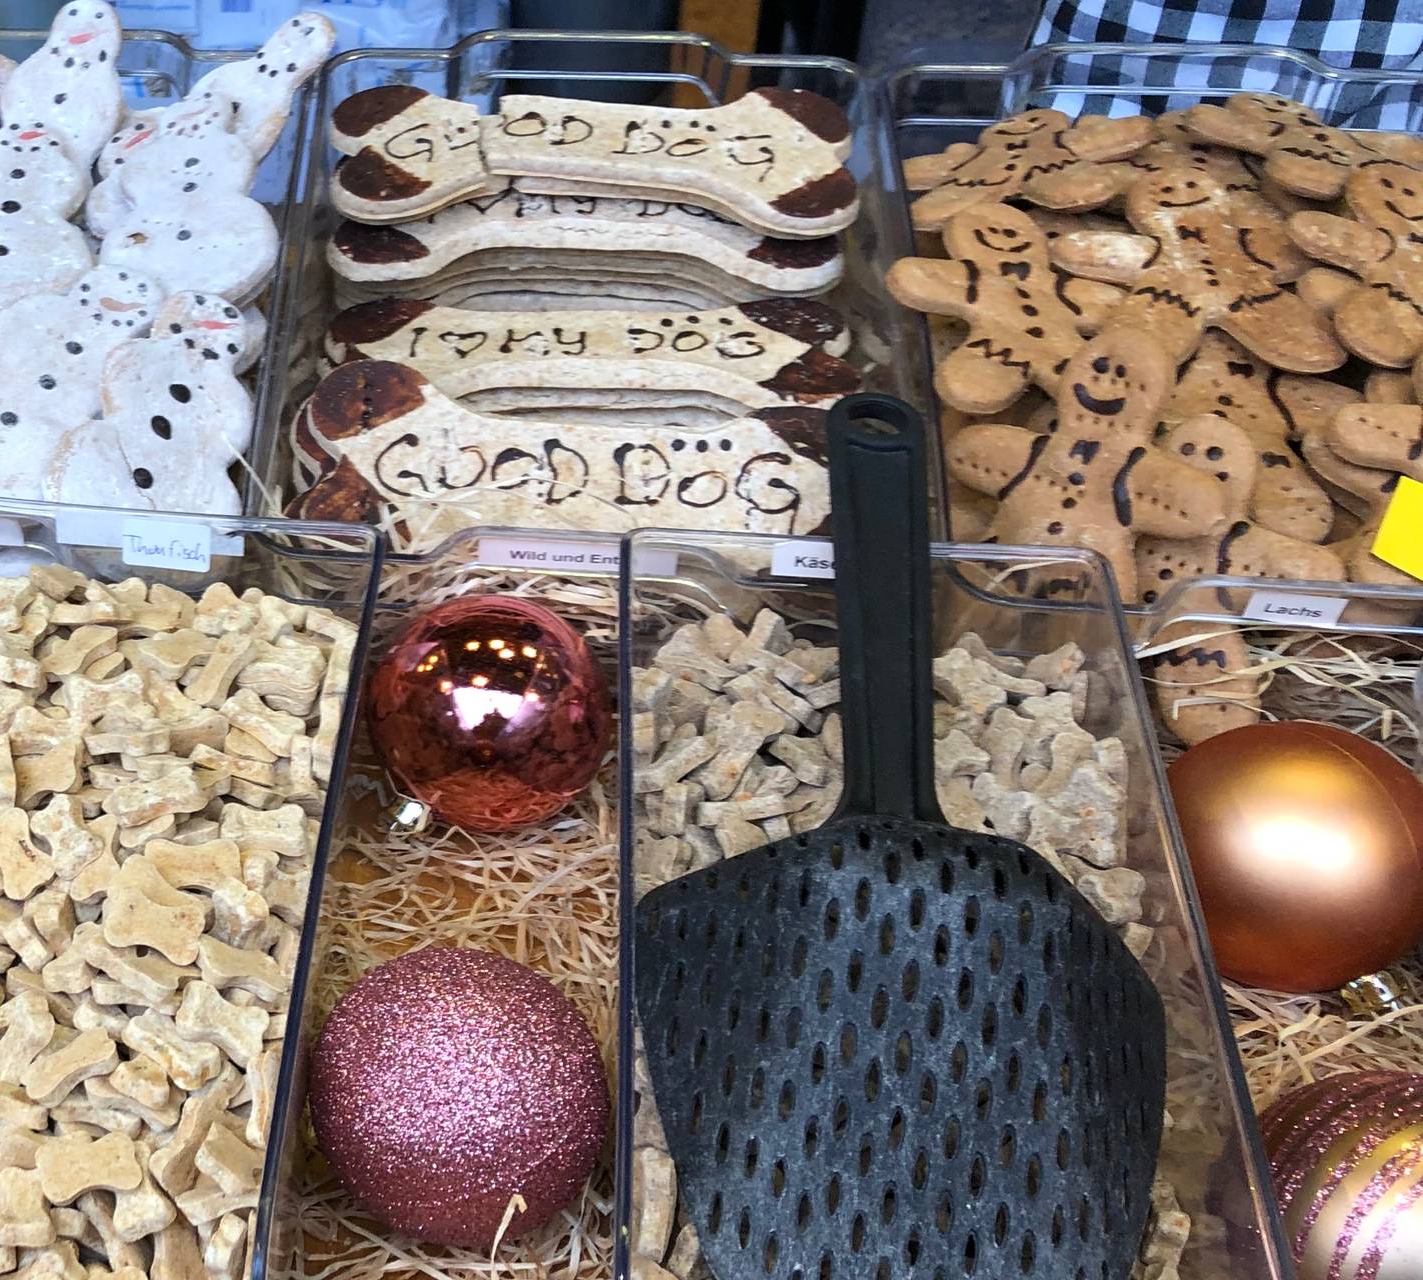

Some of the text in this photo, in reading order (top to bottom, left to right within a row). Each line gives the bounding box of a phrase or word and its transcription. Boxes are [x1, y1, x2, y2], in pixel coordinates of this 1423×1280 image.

[612, 118, 774, 182] DOG
[409, 326, 765, 359] I MY DOG
[375, 432, 802, 533] GOOD DOG
[509, 549, 621, 565] Wild und Ent
[1263, 602, 1323, 618] Lachs
